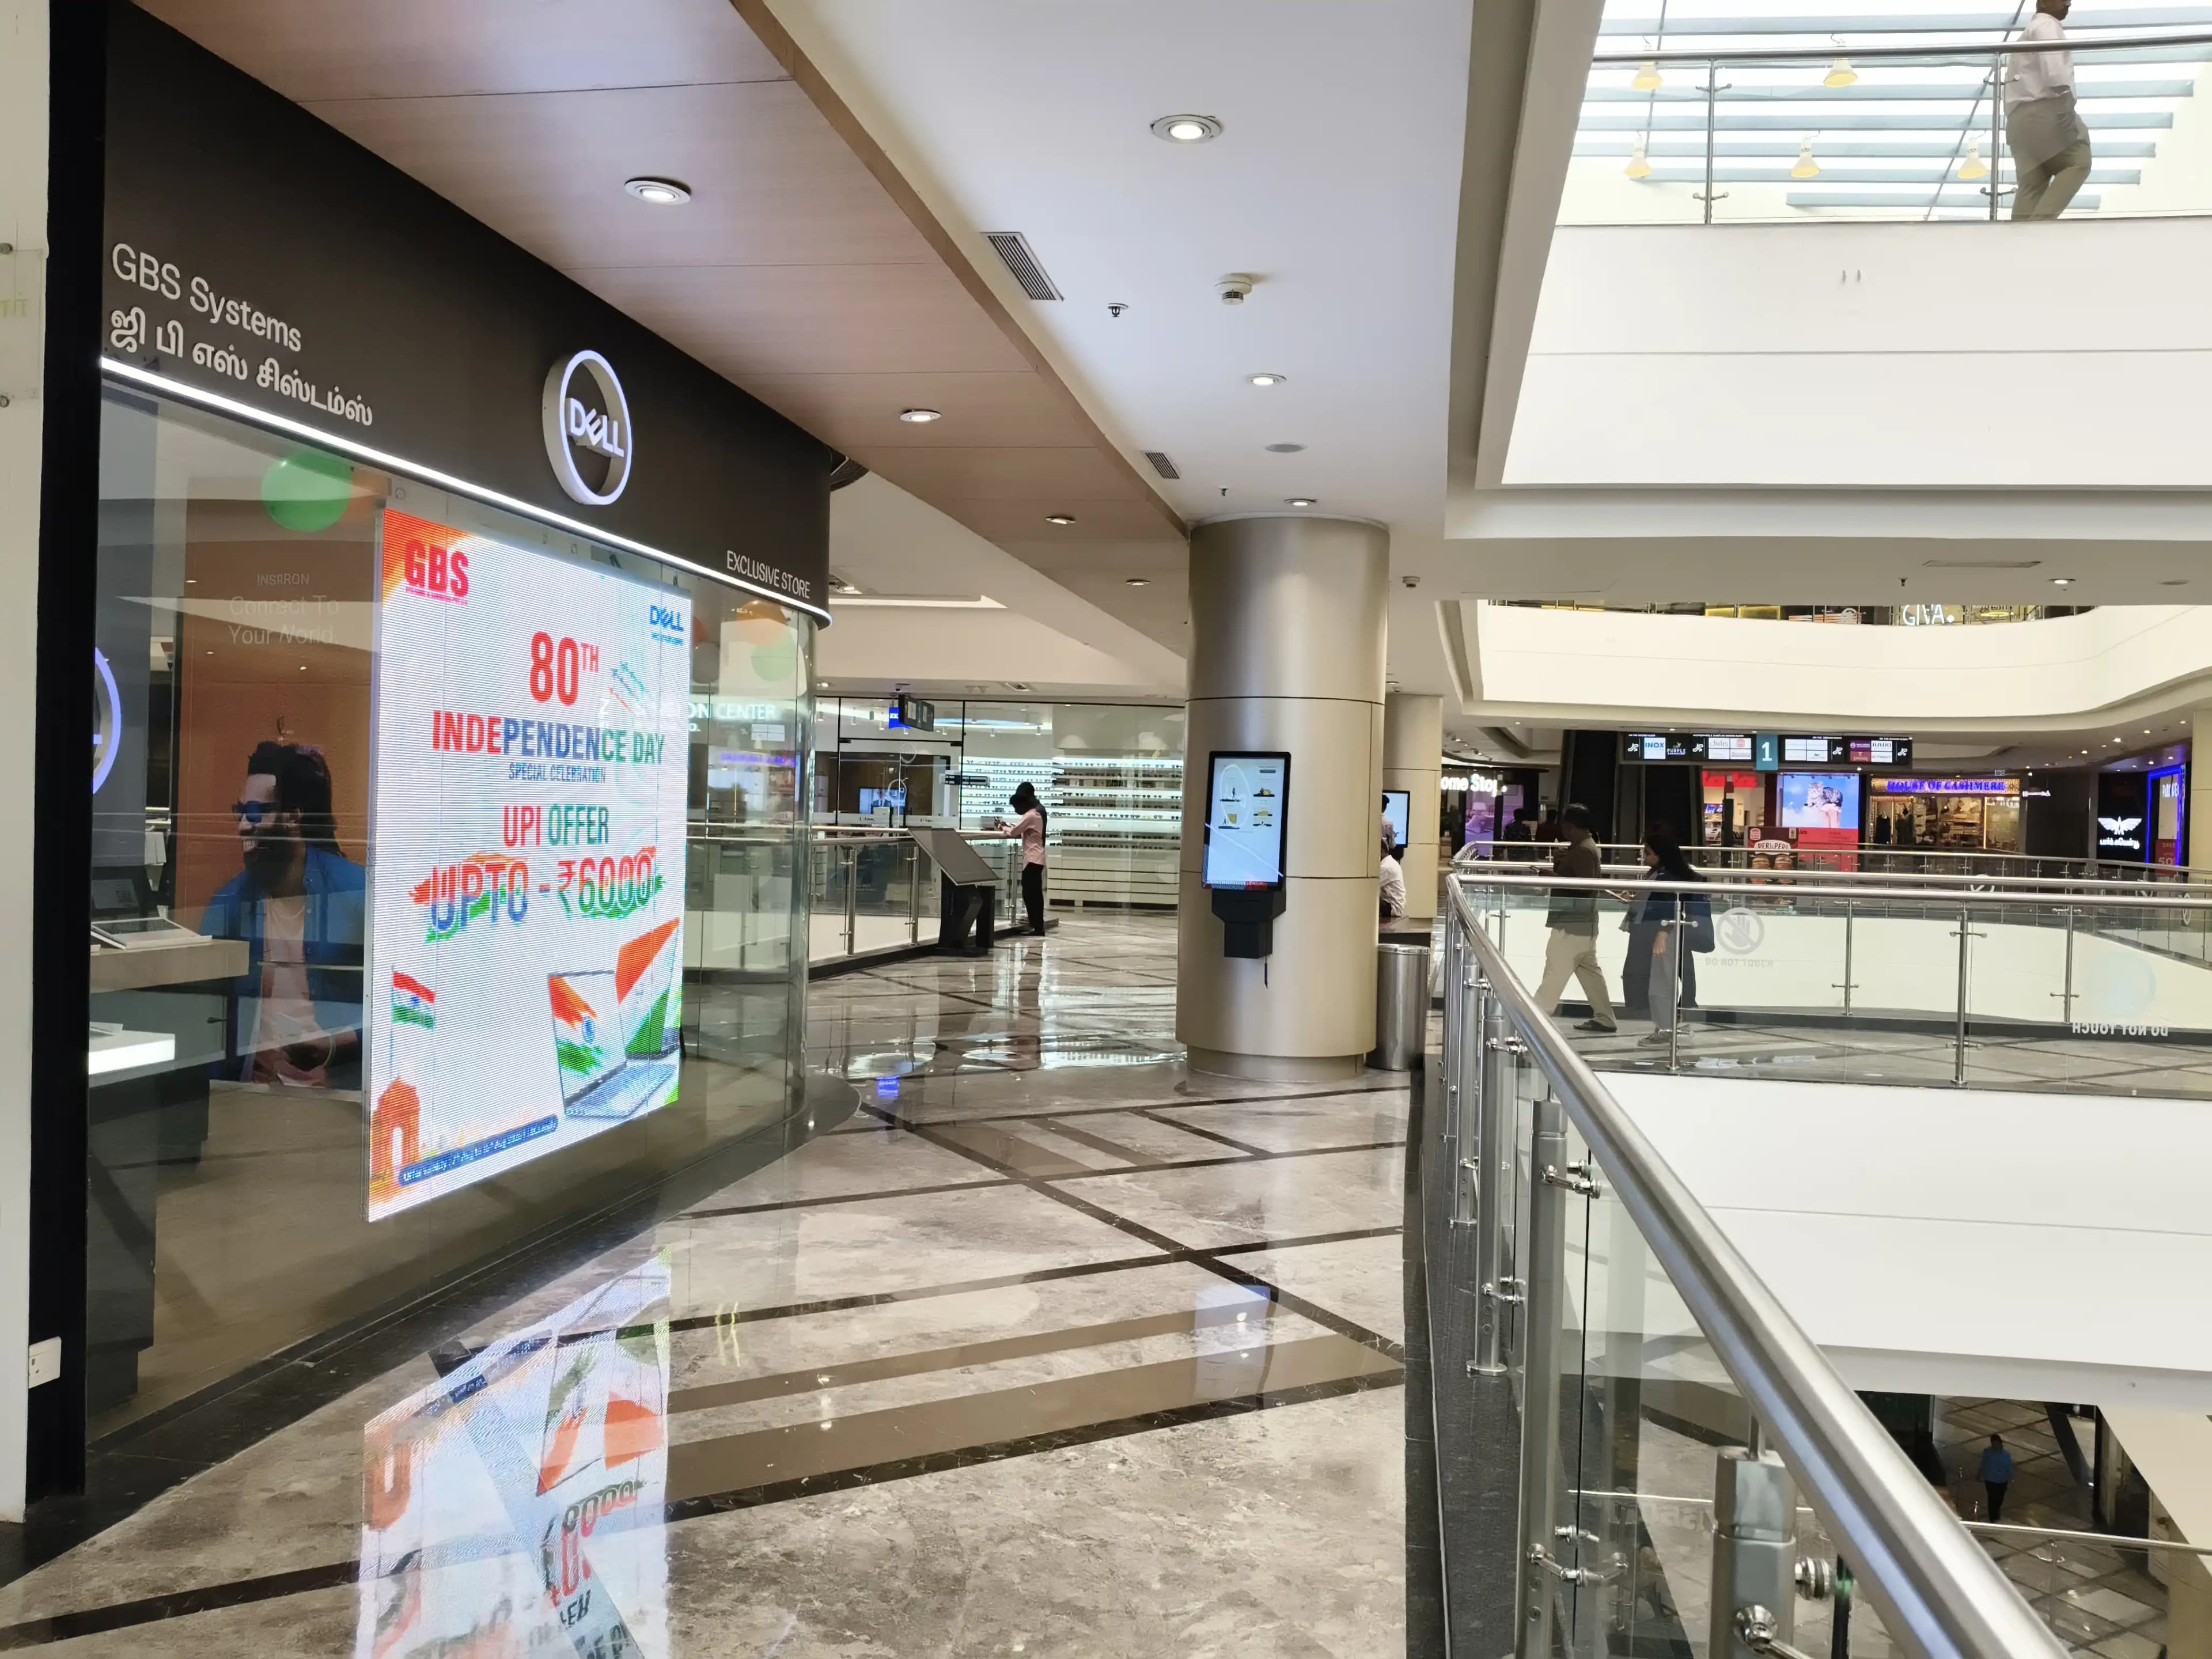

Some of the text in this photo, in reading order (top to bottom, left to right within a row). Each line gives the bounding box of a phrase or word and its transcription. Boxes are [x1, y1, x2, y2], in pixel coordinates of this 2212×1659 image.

[112, 243, 301, 352] GBS Systems
[111, 306, 146, 353] ஜி
[156, 320, 183, 358] பி
[192, 342, 248, 380] எஸ்
[569, 397, 624, 457] DELL
[404, 540, 469, 598] GBS
[727, 550, 810, 599] EXCLUSIVE STORE
[230, 594, 339, 616] Connect To
[1903, 604, 1945, 626] GIVA
[650, 604, 684, 632] DELL
[228, 624, 271, 645] Your
[715, 703, 777, 720] CENTER
[433, 710, 665, 765] INDEPENDENCE DAY
[1762, 741, 1772, 761] 1
[509, 762, 606, 784] SPECIAL CELEBRATION
[1441, 777, 1468, 791] ome
[1929, 781, 1942, 791] OF
[1944, 781, 2006, 793] CASHMERE
[503, 804, 609, 848] UPI OFFER
[431, 861, 529, 931] UPTO
[1705, 957, 1774, 968] DO NOT TOUCH
